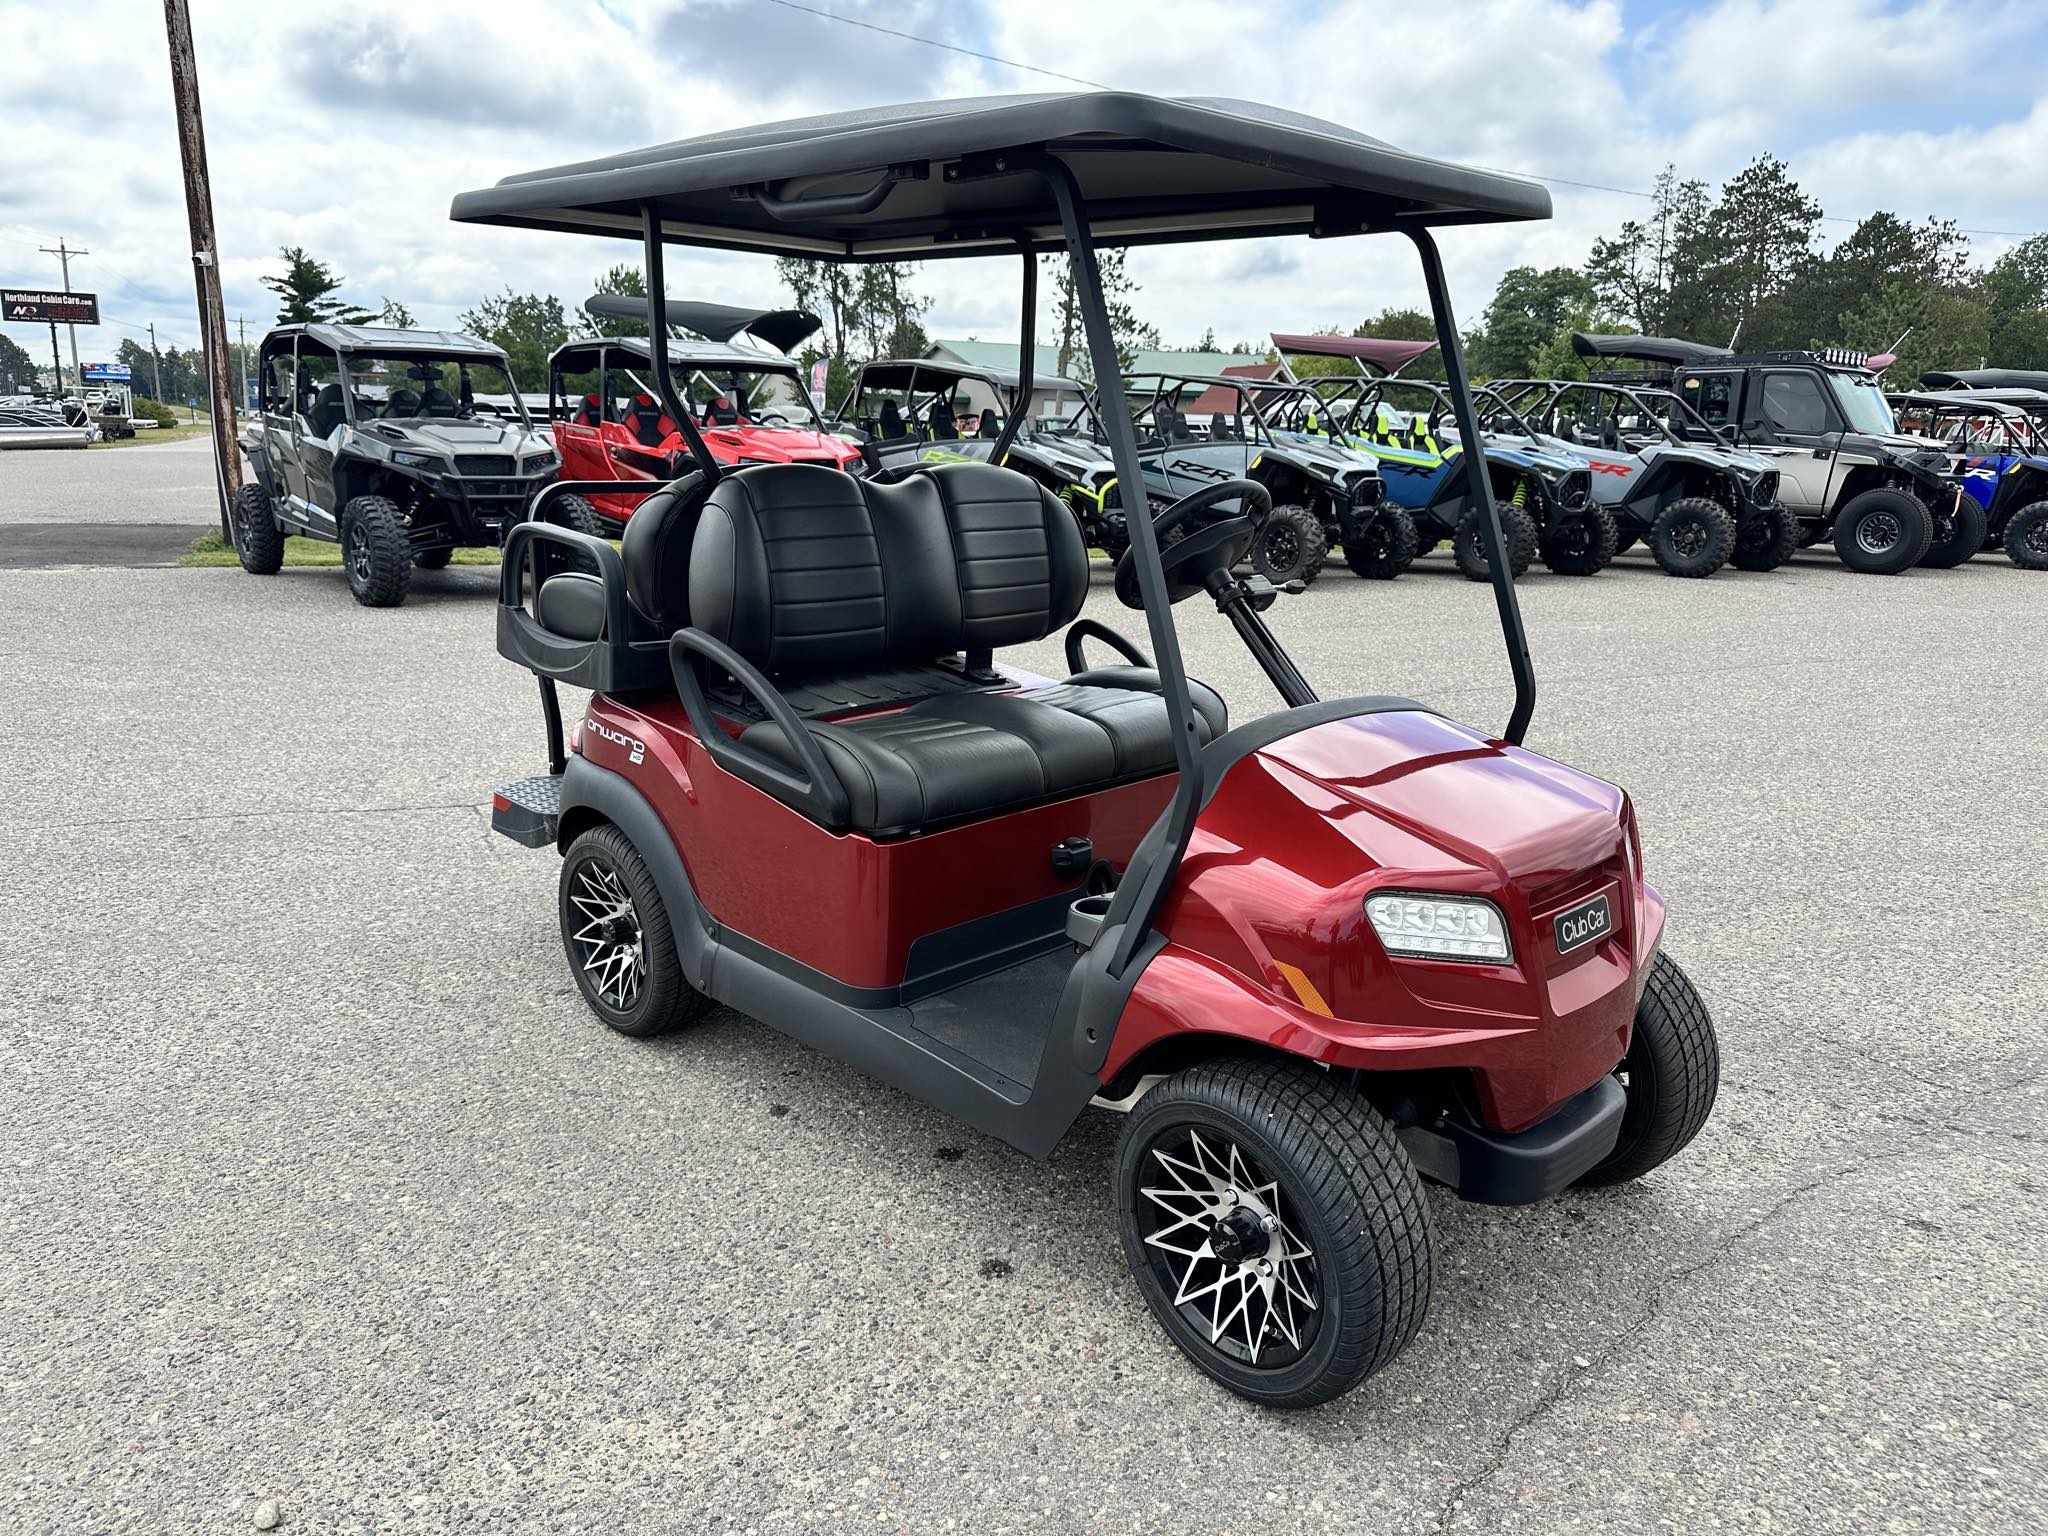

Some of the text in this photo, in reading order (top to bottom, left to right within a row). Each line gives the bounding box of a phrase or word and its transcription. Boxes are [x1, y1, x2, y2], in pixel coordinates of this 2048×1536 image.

[1169, 459, 1236, 481] RZR
[1562, 909, 1605, 943] Club Car
